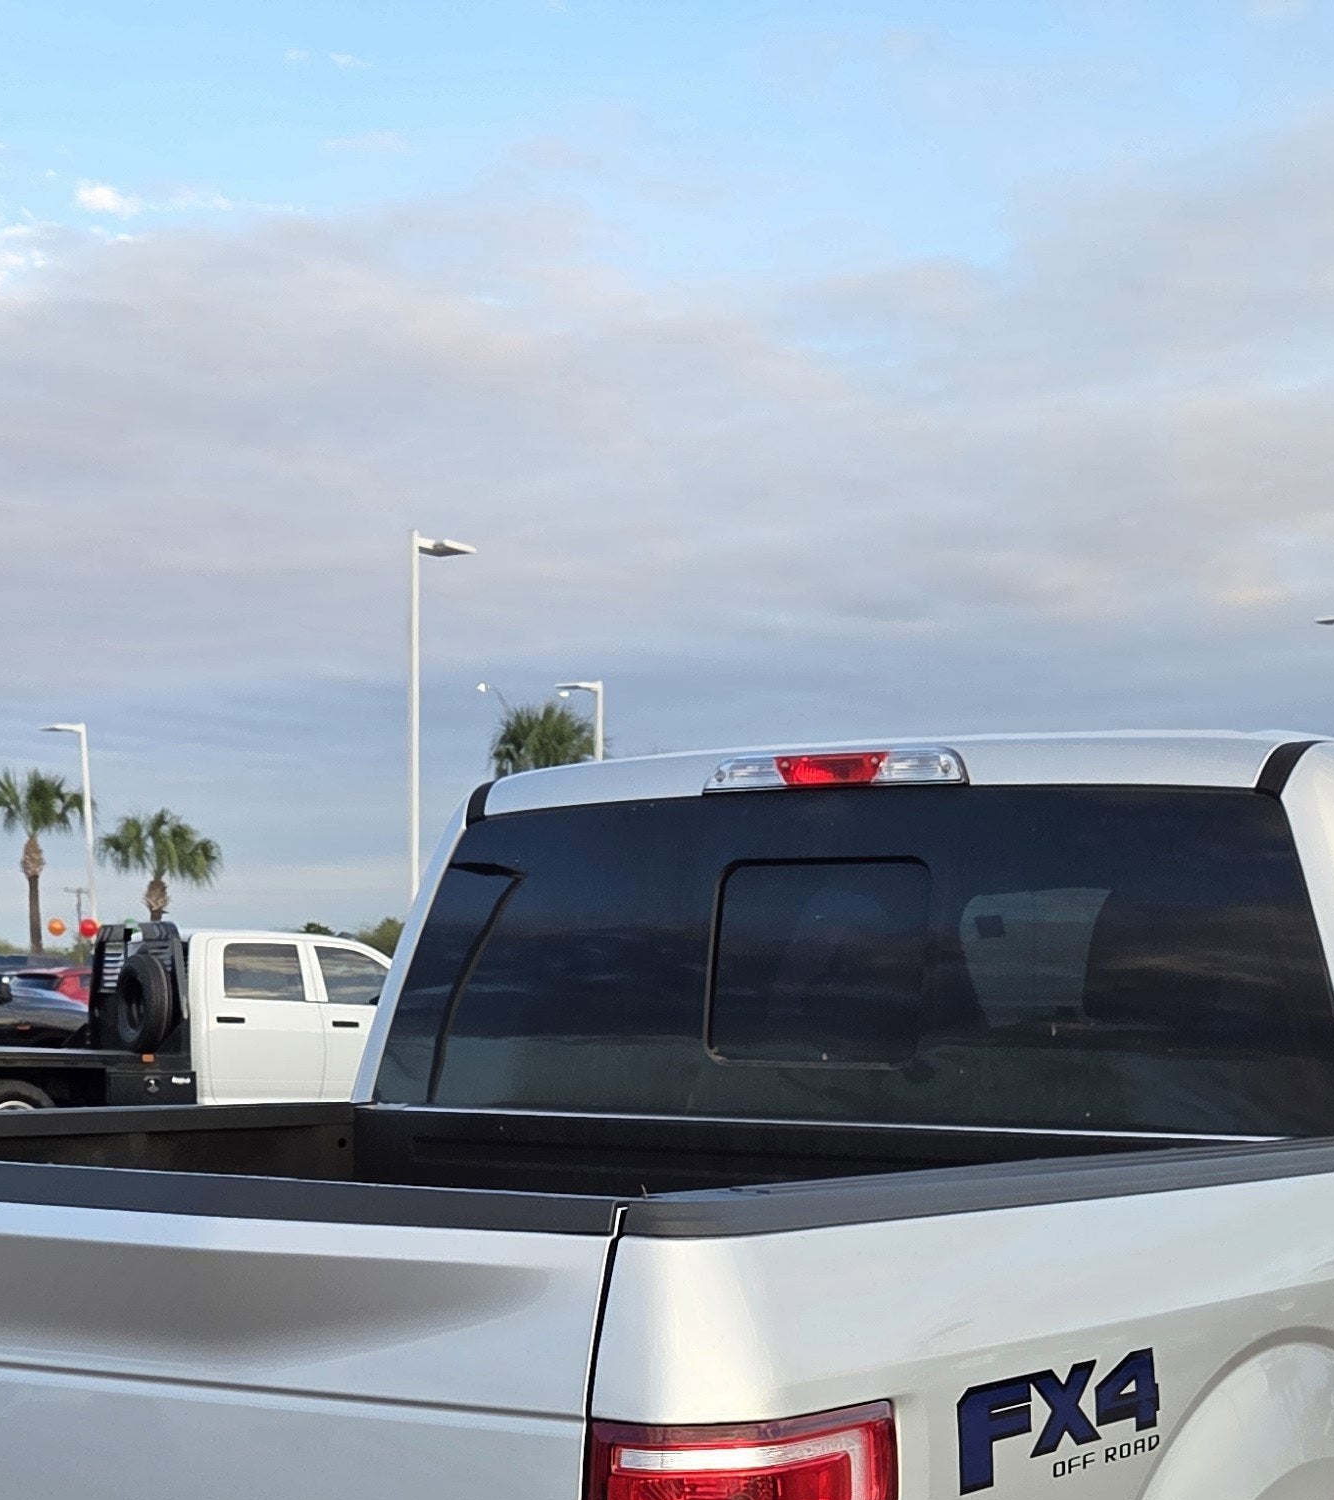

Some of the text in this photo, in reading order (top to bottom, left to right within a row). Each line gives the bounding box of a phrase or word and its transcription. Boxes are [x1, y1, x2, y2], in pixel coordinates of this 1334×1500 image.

[956, 1346, 1160, 1496] FX4
[1053, 1433, 1160, 1478] OFF ROAD
